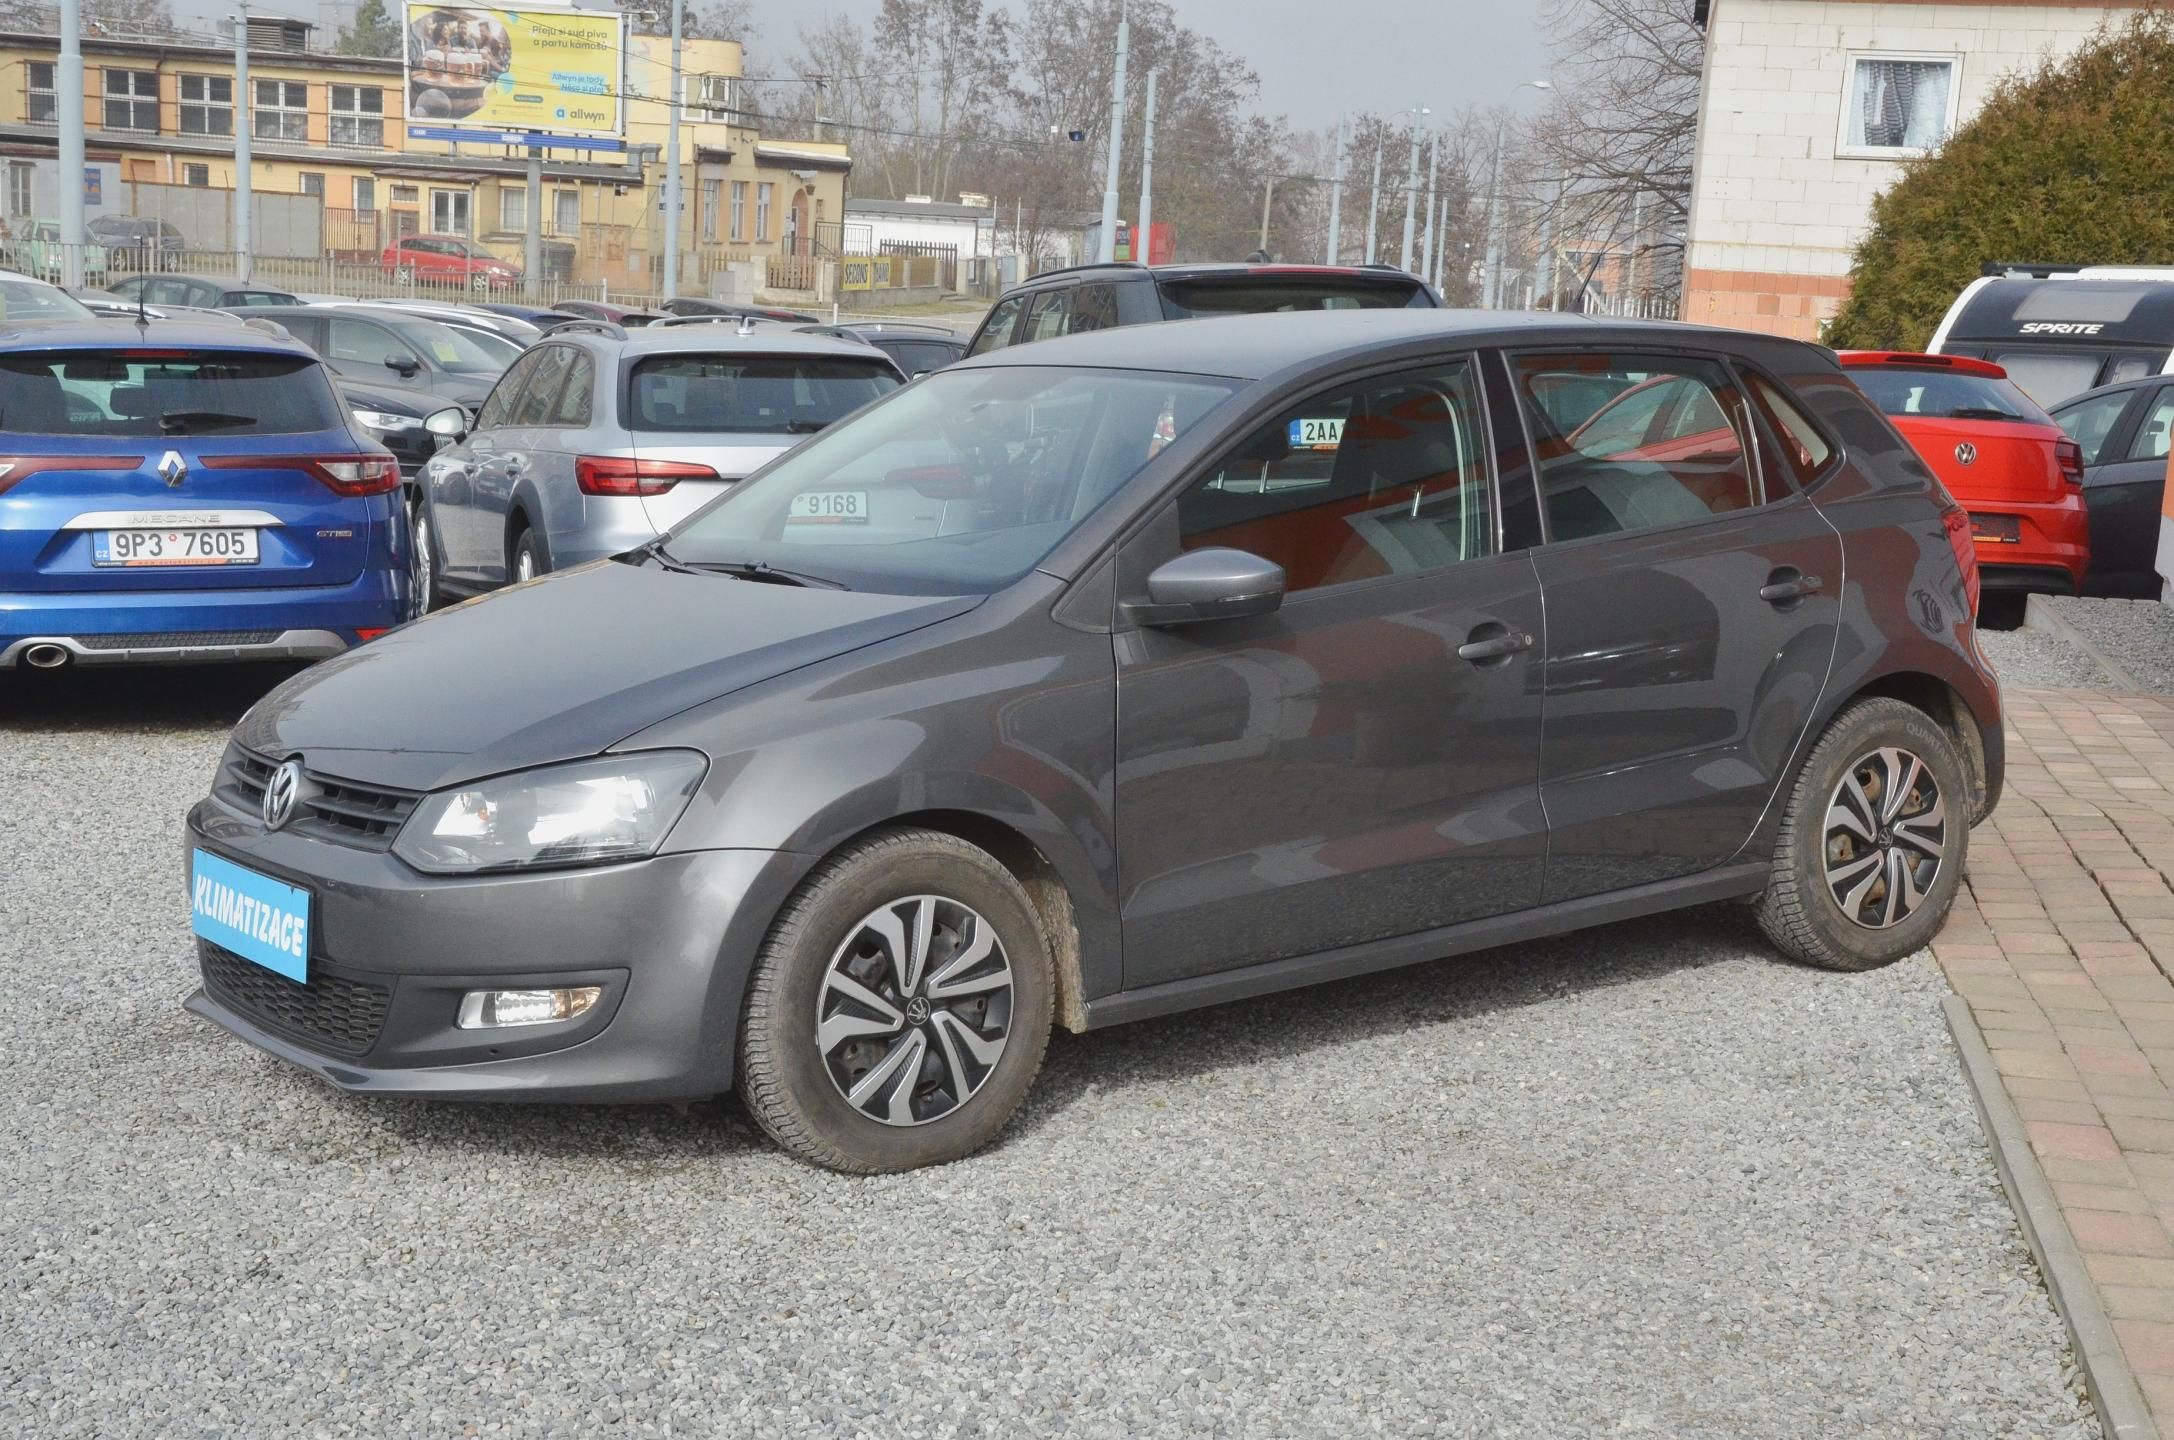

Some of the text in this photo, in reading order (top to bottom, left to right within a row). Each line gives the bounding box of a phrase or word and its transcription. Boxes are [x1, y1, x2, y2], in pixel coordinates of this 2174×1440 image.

[541, 39, 568, 48] partu
[567, 28, 584, 37] sud
[587, 29, 608, 40] piva
[570, 109, 605, 123] allwyn
[1305, 422, 1338, 441] 2AA
[808, 495, 857, 514] 9168
[96, 532, 246, 558] CZ 9P3 7605
[194, 873, 305, 957] KLIMATIZACE
